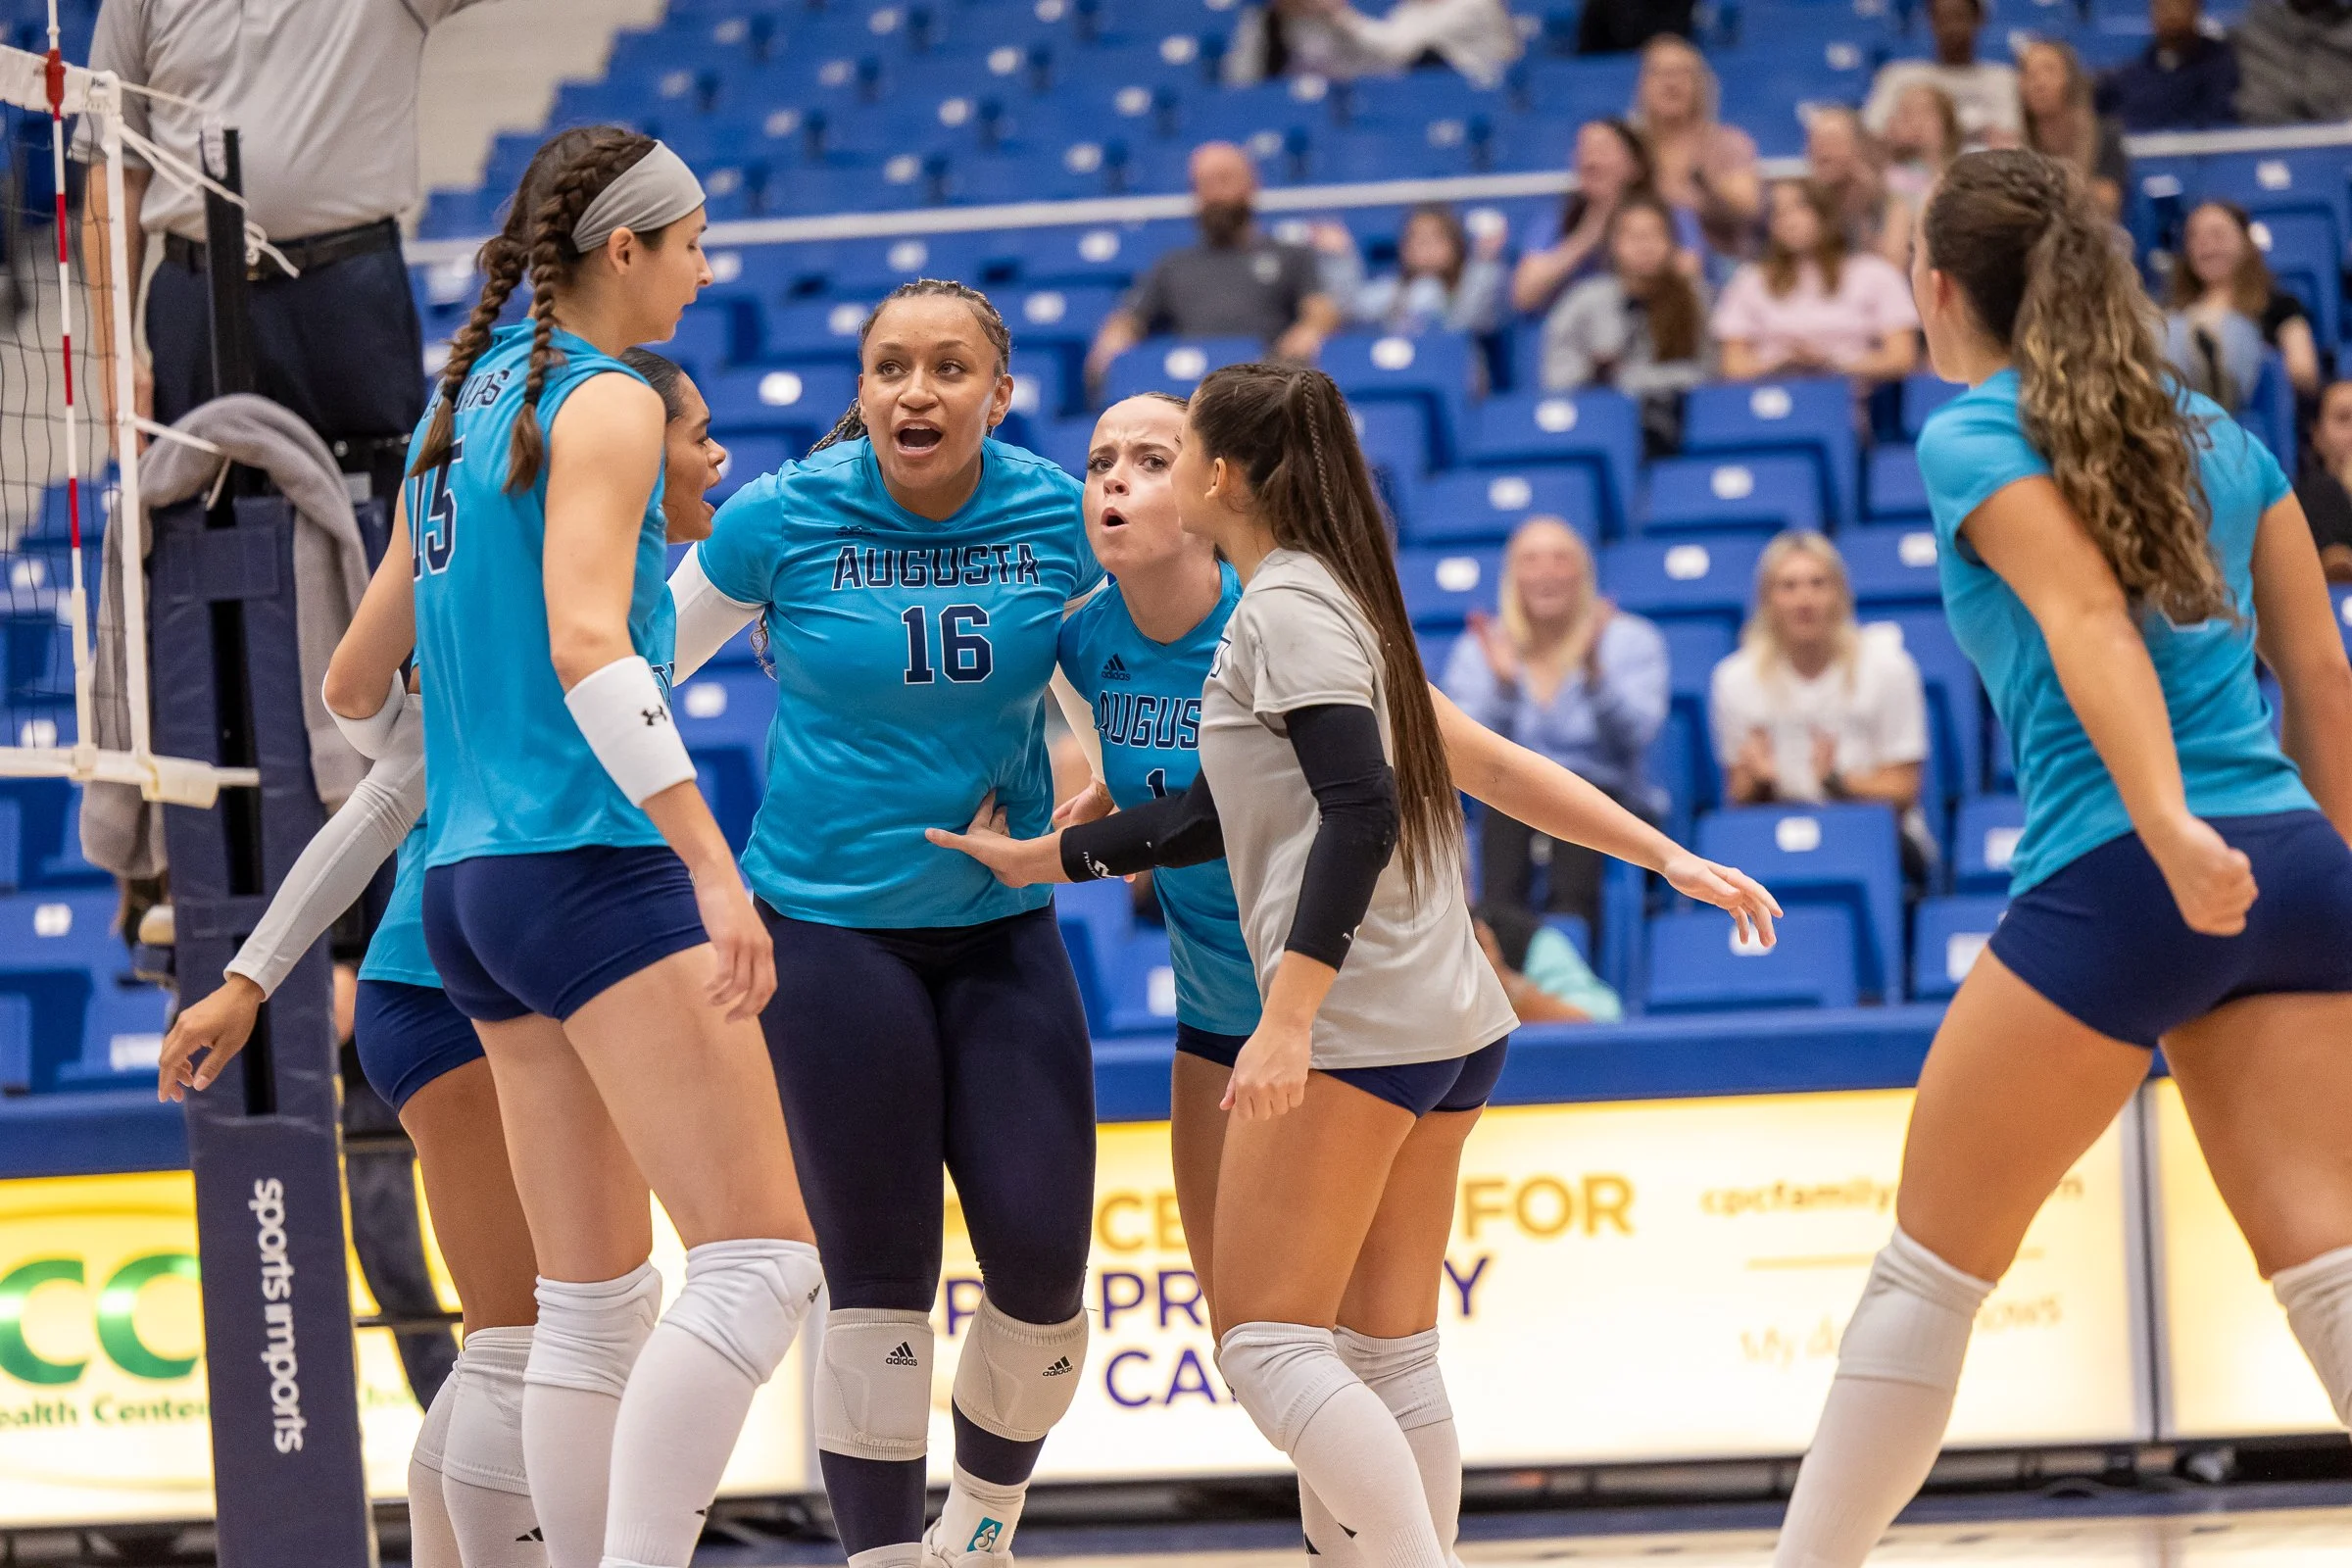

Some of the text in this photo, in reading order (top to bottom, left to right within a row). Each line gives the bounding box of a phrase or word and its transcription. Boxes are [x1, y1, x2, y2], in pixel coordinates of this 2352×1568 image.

[413, 434, 466, 582] 15
[831, 543, 1041, 591] AUGUSTA
[901, 604, 993, 685] 16
[1101, 670, 1132, 682] adidas
[1097, 690, 1202, 751] AUGUS
[1463, 1174, 1634, 1242] FOR
[248, 1177, 307, 1453] sports imports
[885, 1355, 918, 1367] adidas
[1042, 1364, 1073, 1377] adidas
[0, 1398, 78, 1426] ealth
